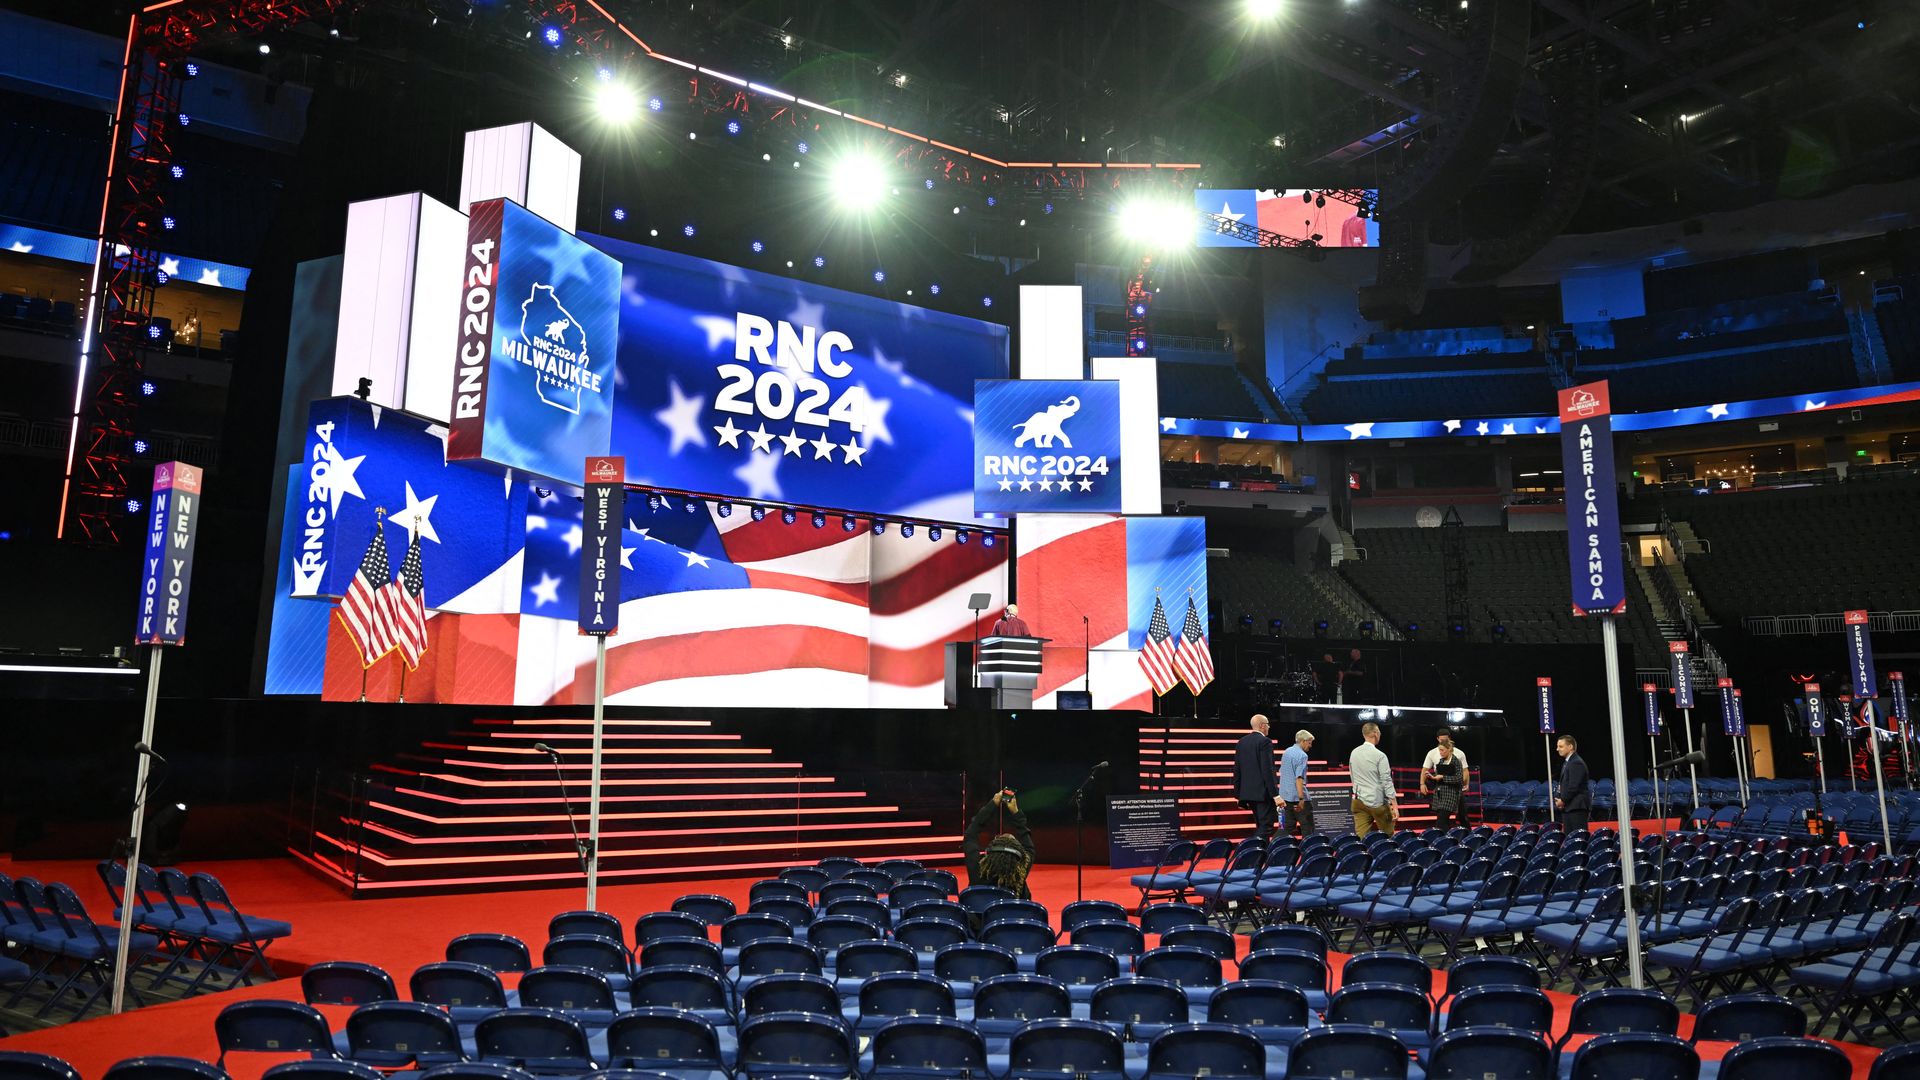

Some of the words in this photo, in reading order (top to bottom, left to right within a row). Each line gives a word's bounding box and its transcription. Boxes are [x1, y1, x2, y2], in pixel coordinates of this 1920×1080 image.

[464, 238, 495, 337] 2024
[502, 336, 602, 393] MILWAUKEE
[534, 336, 552, 352] RNC
[553, 345, 576, 362] 2024
[735, 312, 854, 378] RNC
[456, 342, 486, 419] RNC
[714, 364, 867, 432] 2024
[308, 420, 335, 502] 2024
[984, 456, 1038, 475] RNC
[1040, 456, 1109, 475] 2024
[1579, 424, 1599, 528] AMERICAN
[152, 494, 166, 548] NEW
[174, 496, 191, 550] NEW
[302, 506, 327, 572] RNC
[597, 488, 611, 530] WEST
[142, 558, 159, 634] YORK
[165, 558, 184, 635] YORK
[593, 536, 607, 624] VIRGINIA
[1588, 534, 1604, 600] SAMOA
[1675, 653, 1687, 704] WISCONSIN
[1854, 626, 1868, 694] PENNSYLVANIA
[1542, 687, 1550, 730] NEBRASKA
[1809, 698, 1821, 728] OHIO
[1843, 702, 1852, 736] WYOMING
